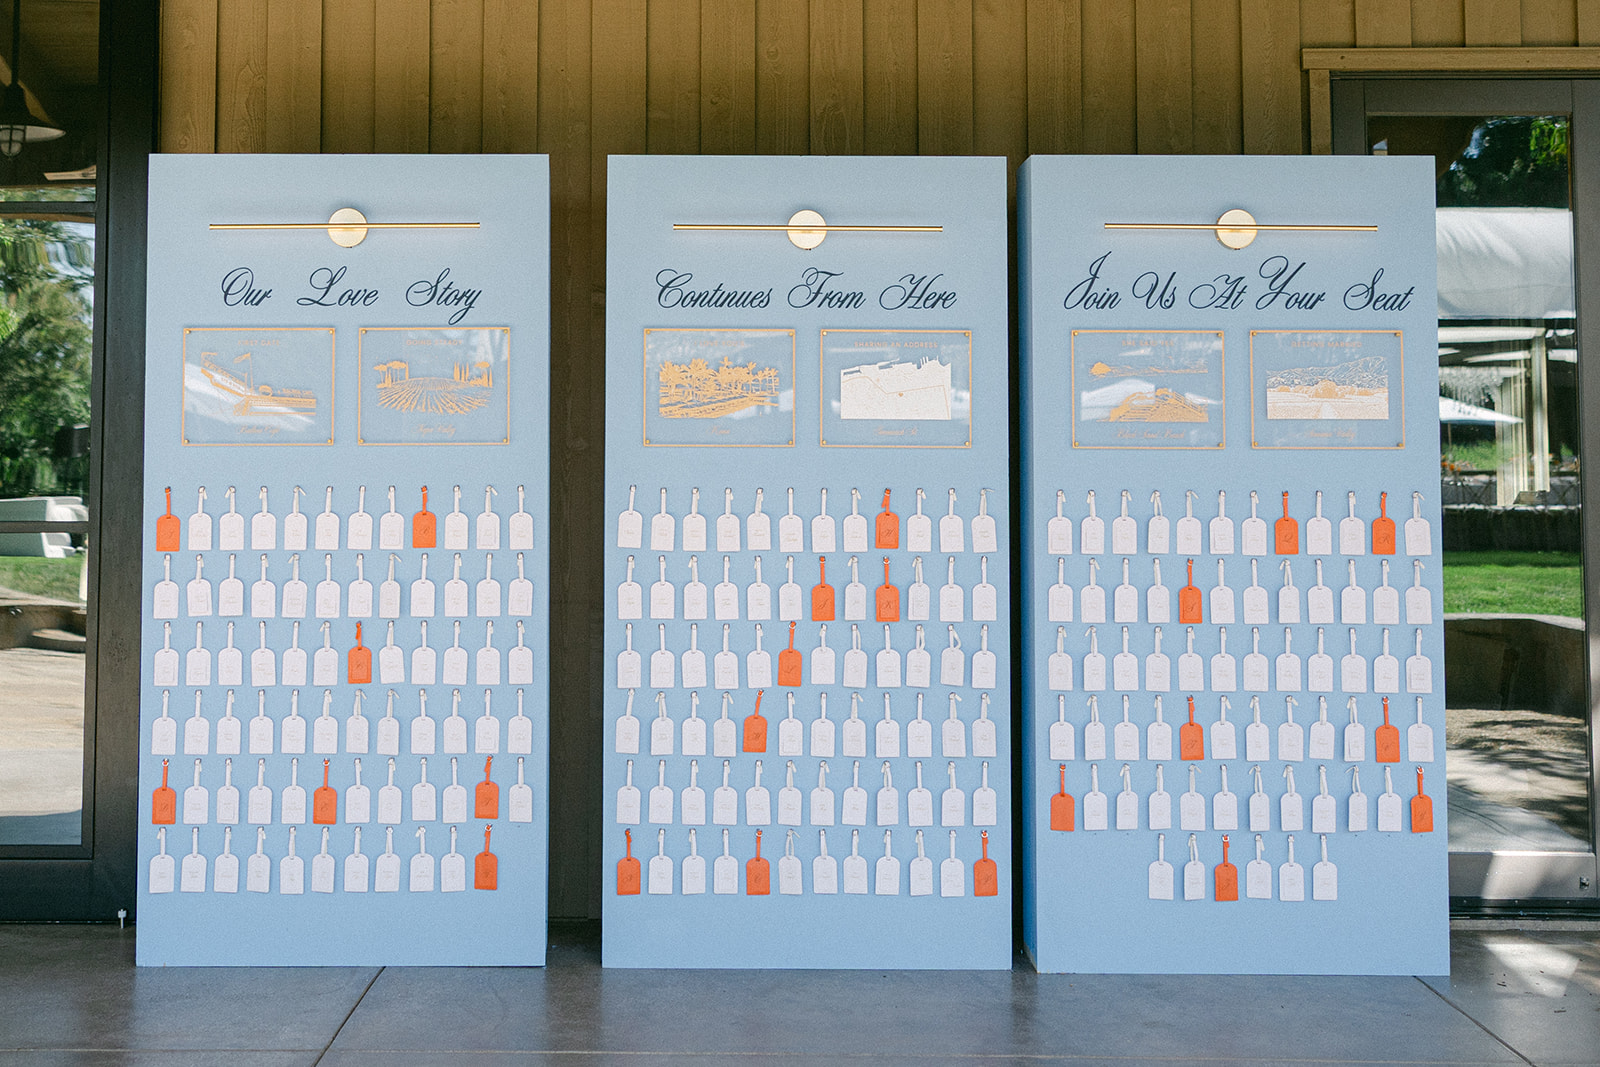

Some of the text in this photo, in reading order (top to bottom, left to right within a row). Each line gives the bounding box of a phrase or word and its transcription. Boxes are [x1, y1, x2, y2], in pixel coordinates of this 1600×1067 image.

[221, 265, 482, 326] Our Love Story
[656, 267, 957, 311] Continues From Here
[1063, 251, 1415, 311] Join Us At Your Seat
